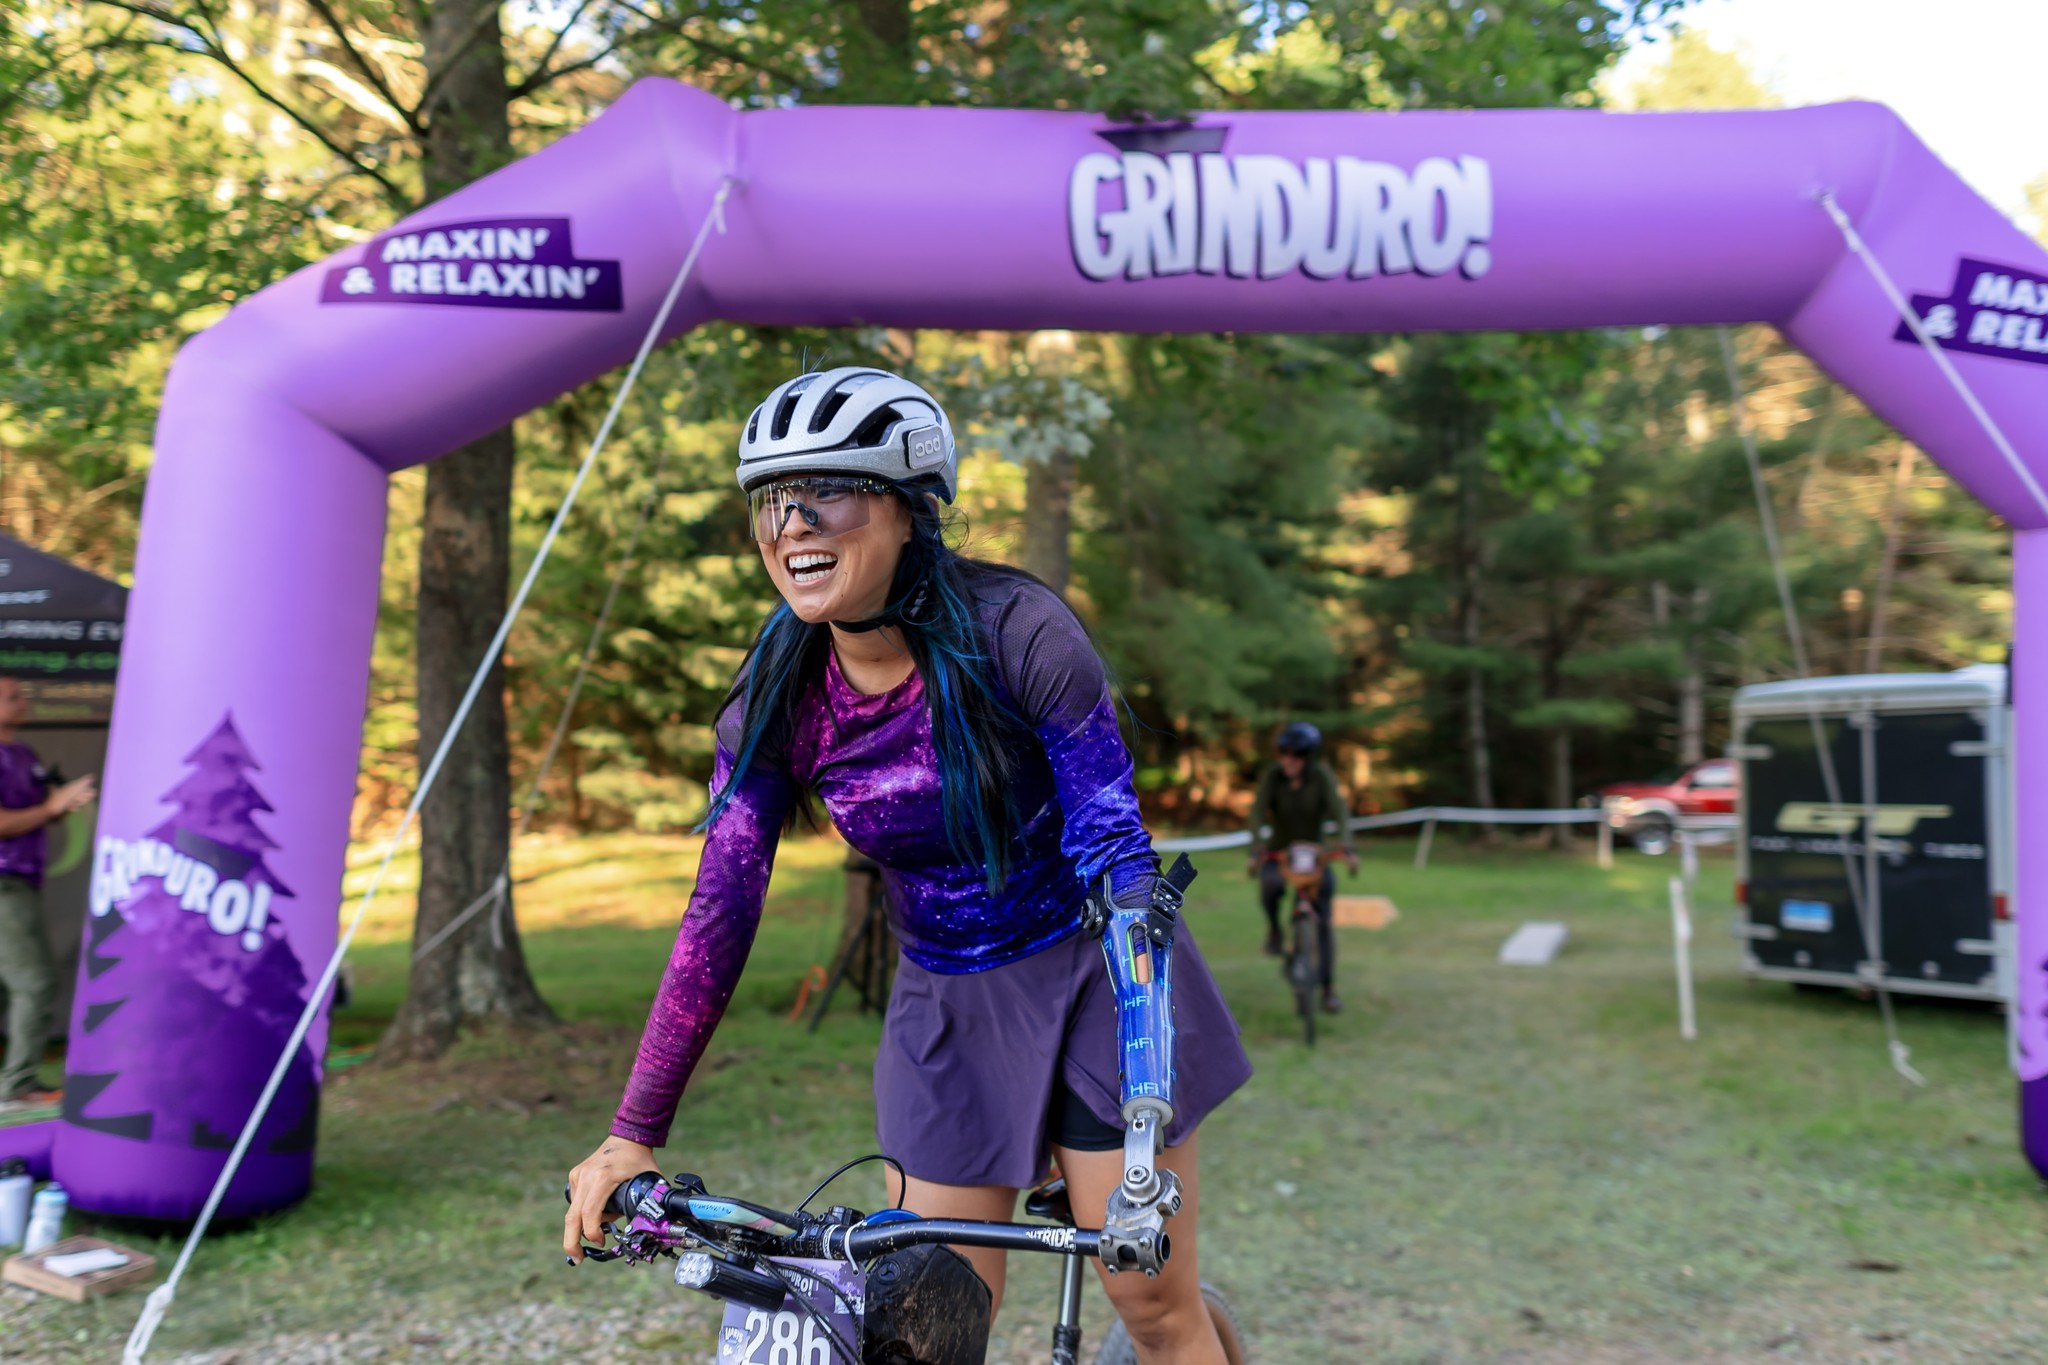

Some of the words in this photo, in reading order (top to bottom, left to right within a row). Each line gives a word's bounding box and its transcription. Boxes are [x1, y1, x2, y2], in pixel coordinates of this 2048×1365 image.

[1070, 152, 1494, 280] GRINDURO!
[380, 228, 550, 262] MAXIN'
[341, 266, 376, 295] &
[390, 263, 601, 299] RELAXIN'
[1967, 309, 2048, 353] REL
[90, 834, 273, 952] GRINDURO!
[742, 1310, 832, 1365] 286
